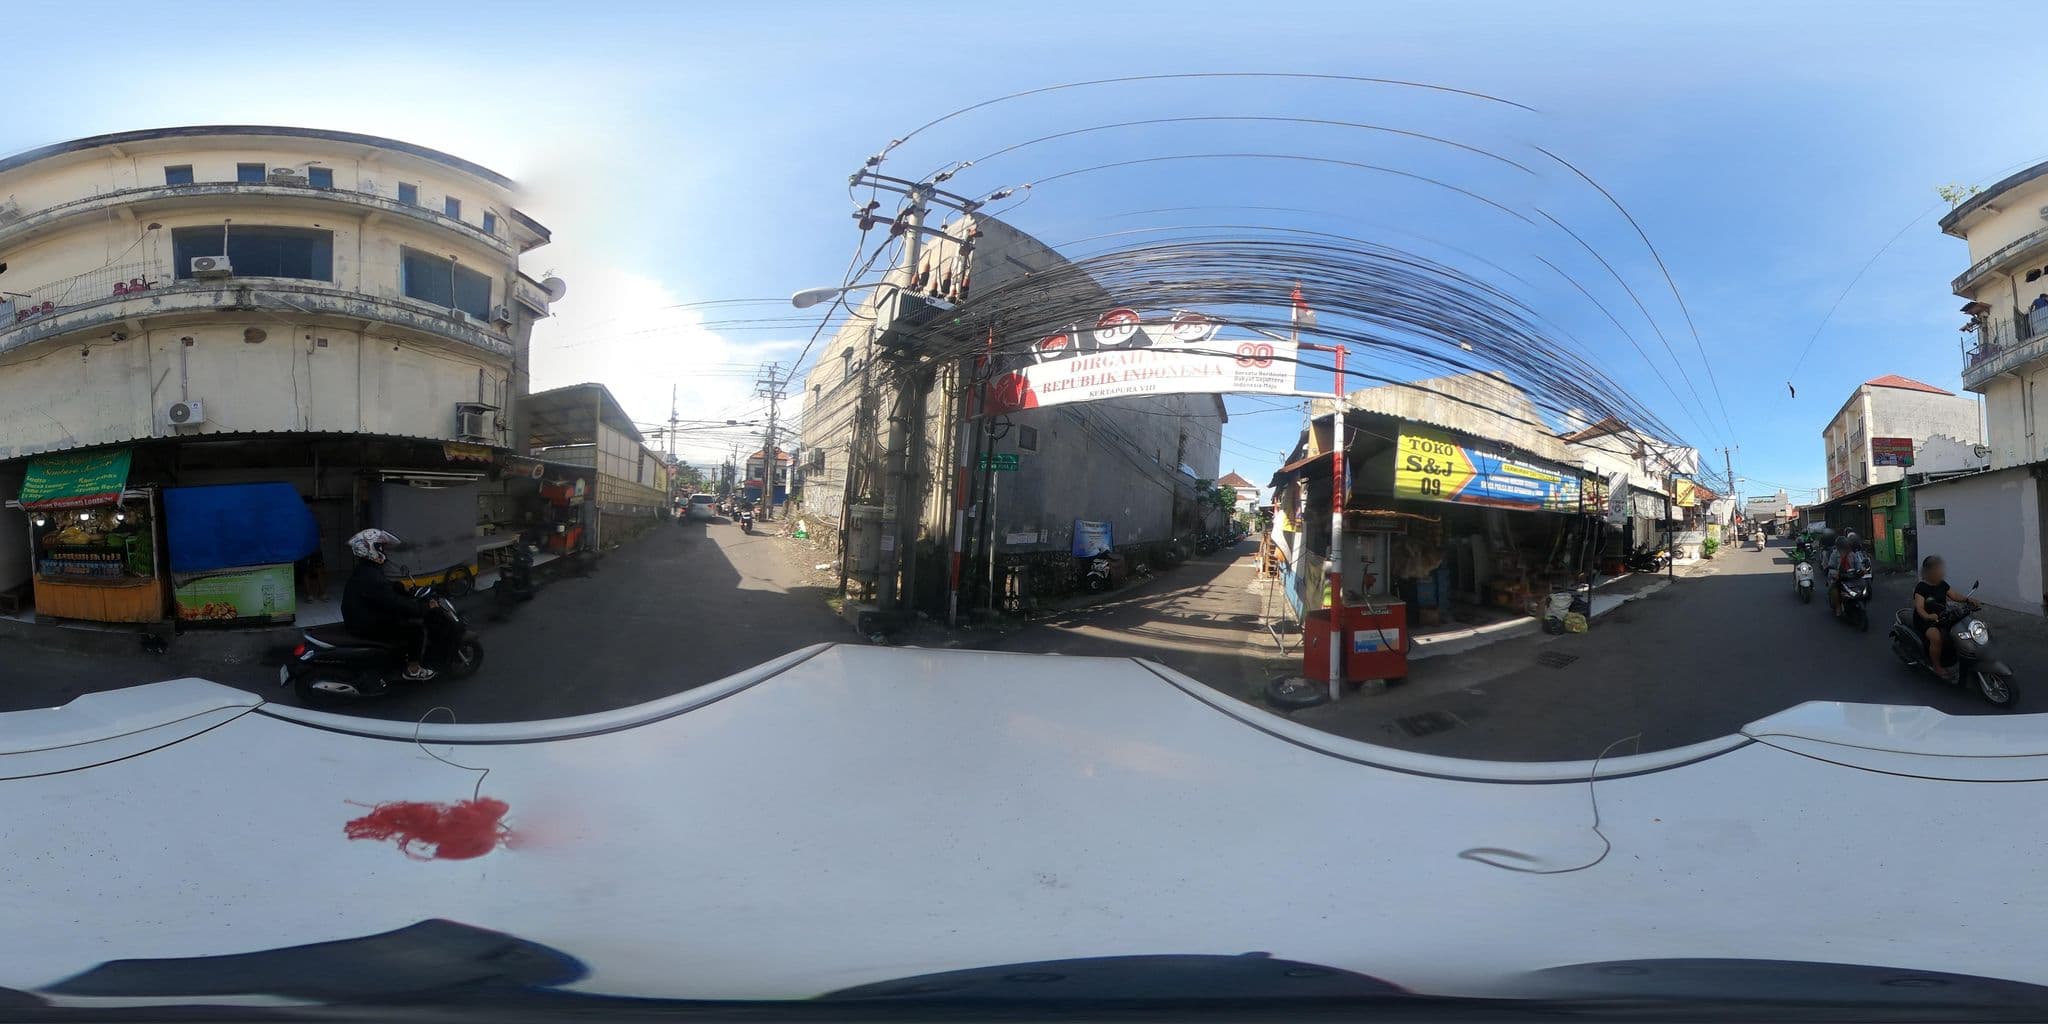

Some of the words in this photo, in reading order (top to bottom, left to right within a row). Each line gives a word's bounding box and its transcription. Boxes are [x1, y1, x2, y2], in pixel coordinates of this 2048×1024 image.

[1070, 349, 1184, 373] DIRGAH
[1042, 372, 1117, 394] REPUBLIK
[1123, 363, 1224, 383] INDONESIA
[1089, 386, 1138, 398] KERTAPURA
[1140, 384, 1156, 392] VIII
[1409, 438, 1453, 457] TOKO
[1406, 455, 1453, 477] S&J
[1421, 477, 1440, 496] 09
